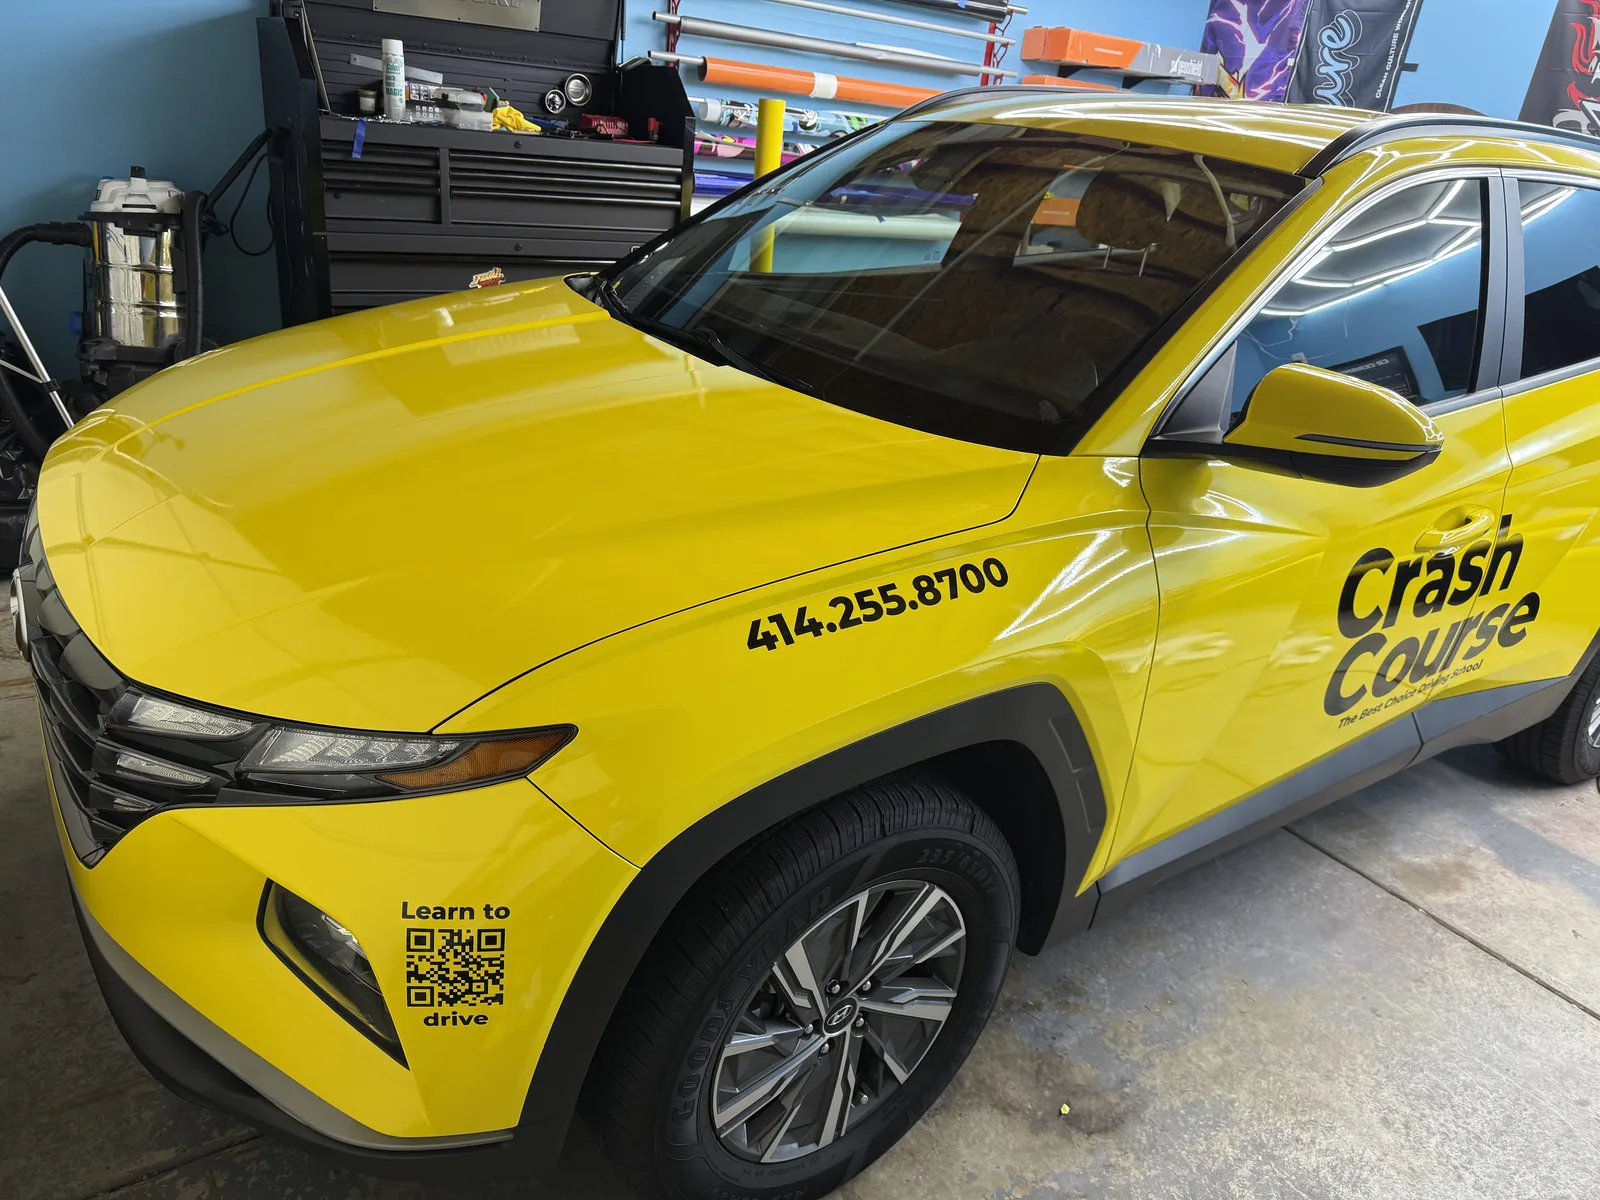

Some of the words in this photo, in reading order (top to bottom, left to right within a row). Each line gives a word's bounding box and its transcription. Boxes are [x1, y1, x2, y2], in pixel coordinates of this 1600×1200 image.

[1314, 12, 1357, 107] ure
[1375, 71, 1388, 98] CLEAN
[1385, 32, 1400, 71] CULTURE
[1395, 0, 1411, 31] WORLD
[746, 557, 1009, 651] 414.255.8700
[1337, 513, 1524, 639] Crash
[1323, 591, 1540, 717] Course
[1338, 715, 1357, 729] The
[1359, 703, 1383, 721] Best
[1384, 688, 1417, 709] Choice
[1417, 673, 1451, 695] Driving
[1451, 659, 1484, 679] School
[401, 901, 475, 920] Learn
[483, 904, 511, 920] to
[423, 1011, 488, 1026] drive
